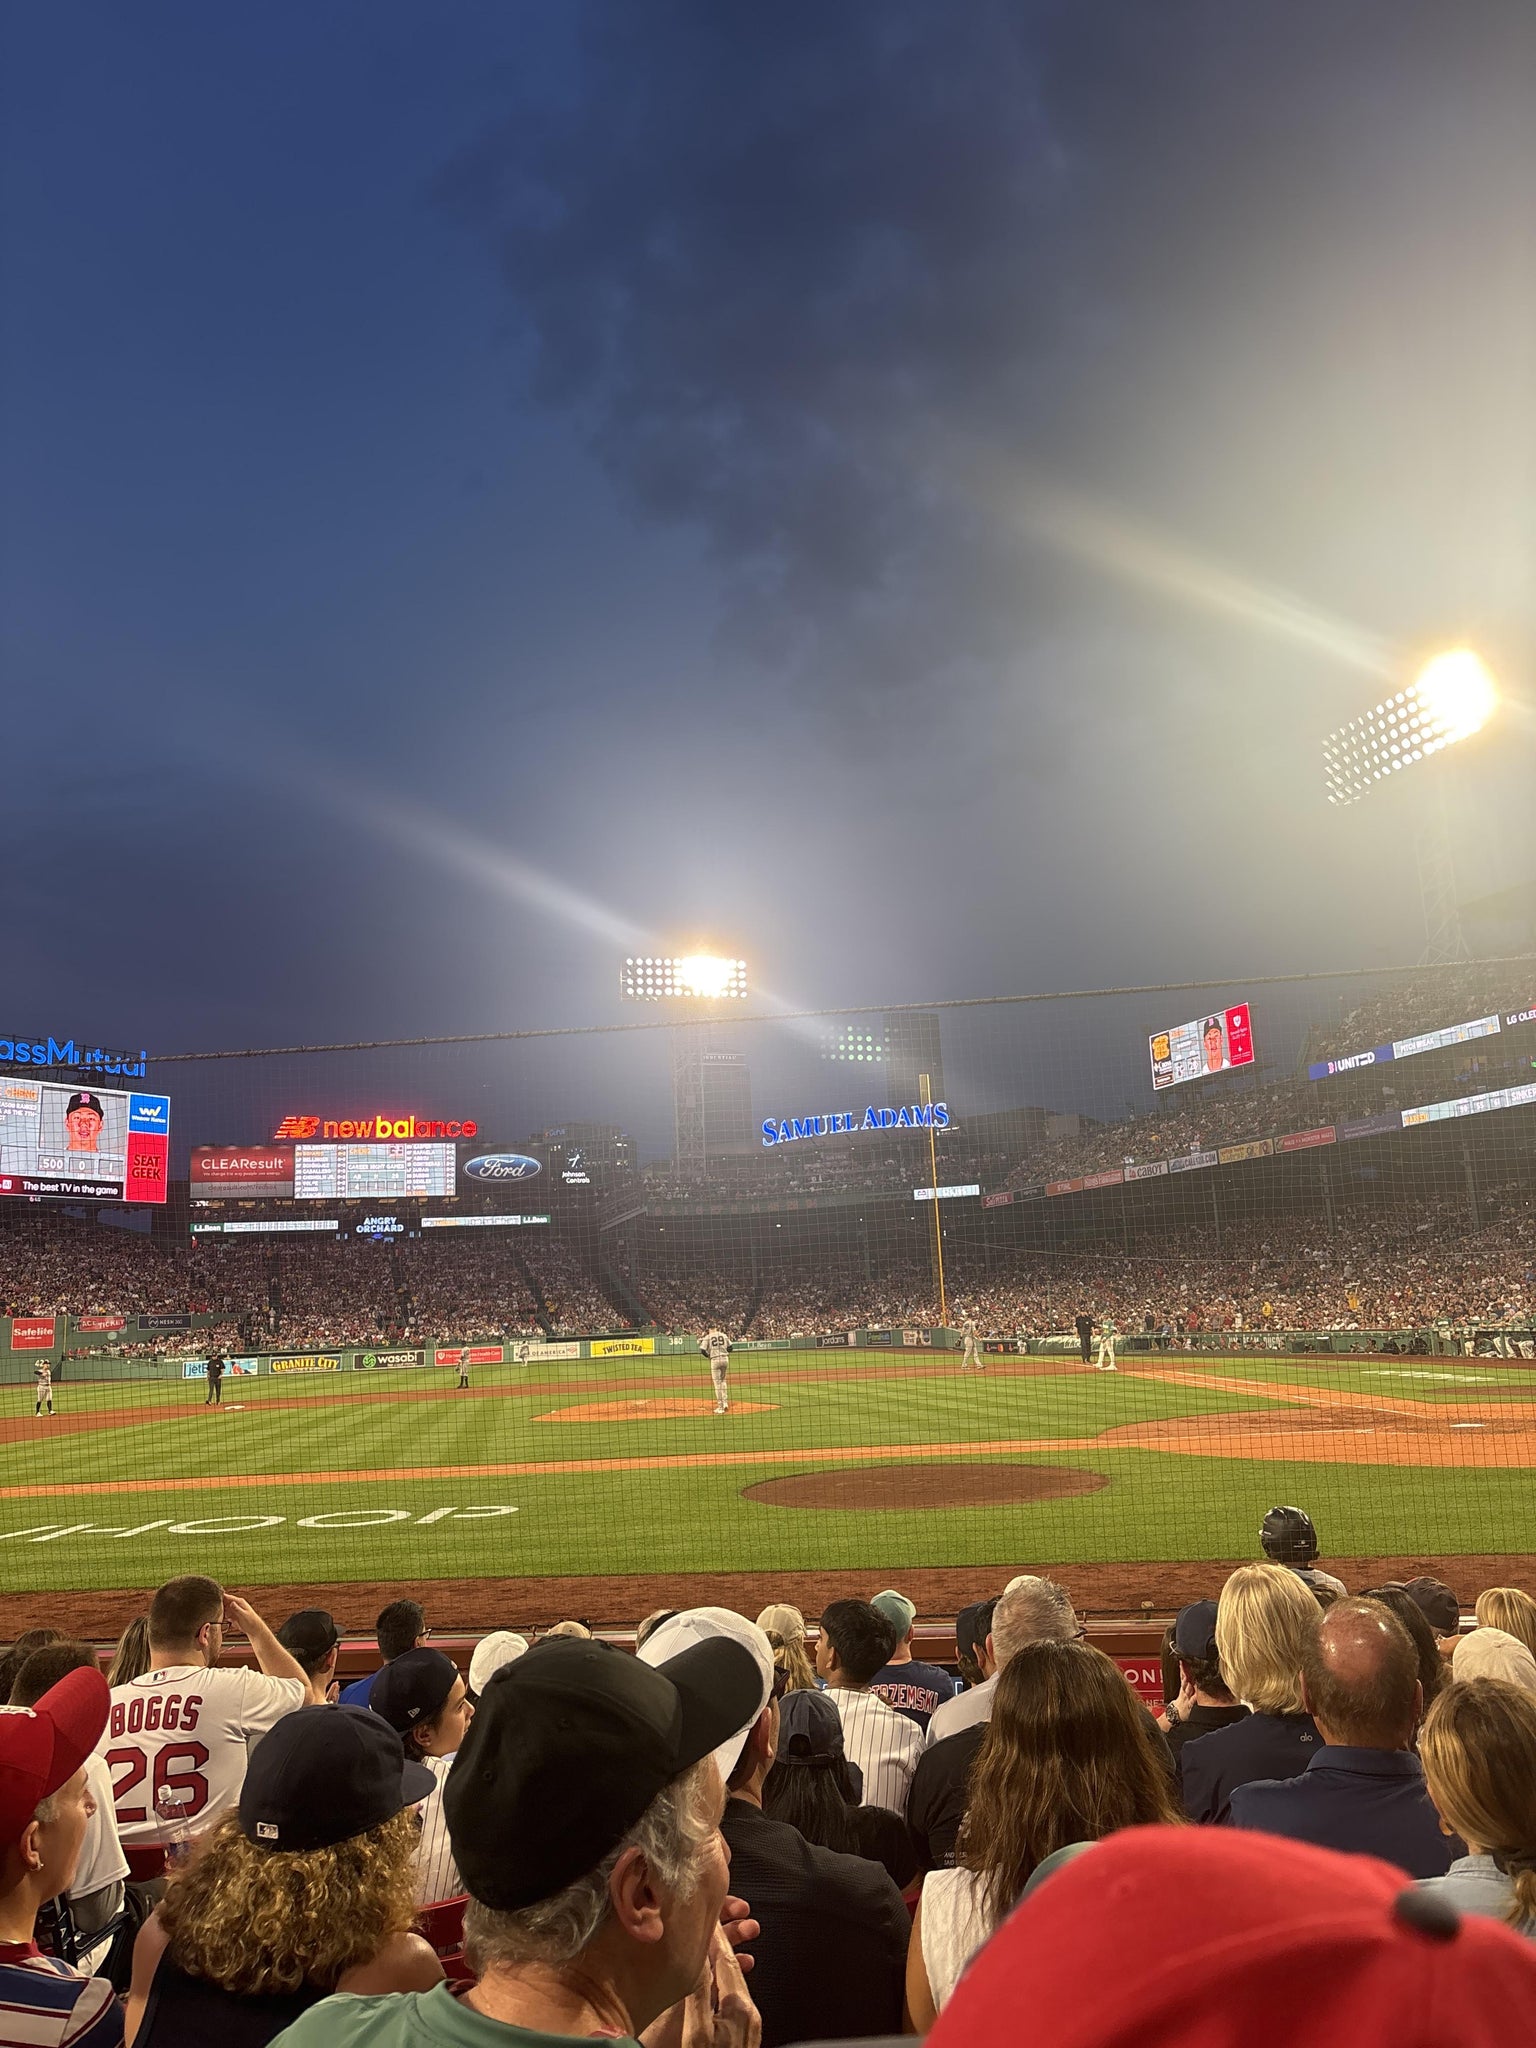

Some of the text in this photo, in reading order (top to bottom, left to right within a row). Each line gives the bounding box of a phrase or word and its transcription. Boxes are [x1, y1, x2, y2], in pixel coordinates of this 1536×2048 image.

[1506, 1014, 1517, 1025] LG
[762, 1102, 950, 1147] SAMUEL ADAMS
[39, 1158, 64, 1170] .500
[134, 1154, 161, 1167] SEAT
[201, 1157, 284, 1170] CLEAResult
[132, 1167, 161, 1180] GEEK
[479, 1158, 526, 1178] Ford
[561, 1171, 586, 1179] Johnson
[23, 1181, 118, 1196] The best TV in the game
[363, 1217, 397, 1226] ANGRY
[356, 1224, 404, 1233] ORCHARD
[98, 1318, 125, 1329] TICKET
[13, 1328, 53, 1337] Safelite
[711, 1336, 725, 1347] 29
[602, 1343, 643, 1354] TWISTED TEA
[377, 1351, 418, 1364] wasabi
[272, 1357, 339, 1372] GRANITE CITY
[868, 1683, 939, 1714] TRZEMSKI
[110, 1694, 203, 1739] BOGGS
[104, 1741, 210, 1823] 26
